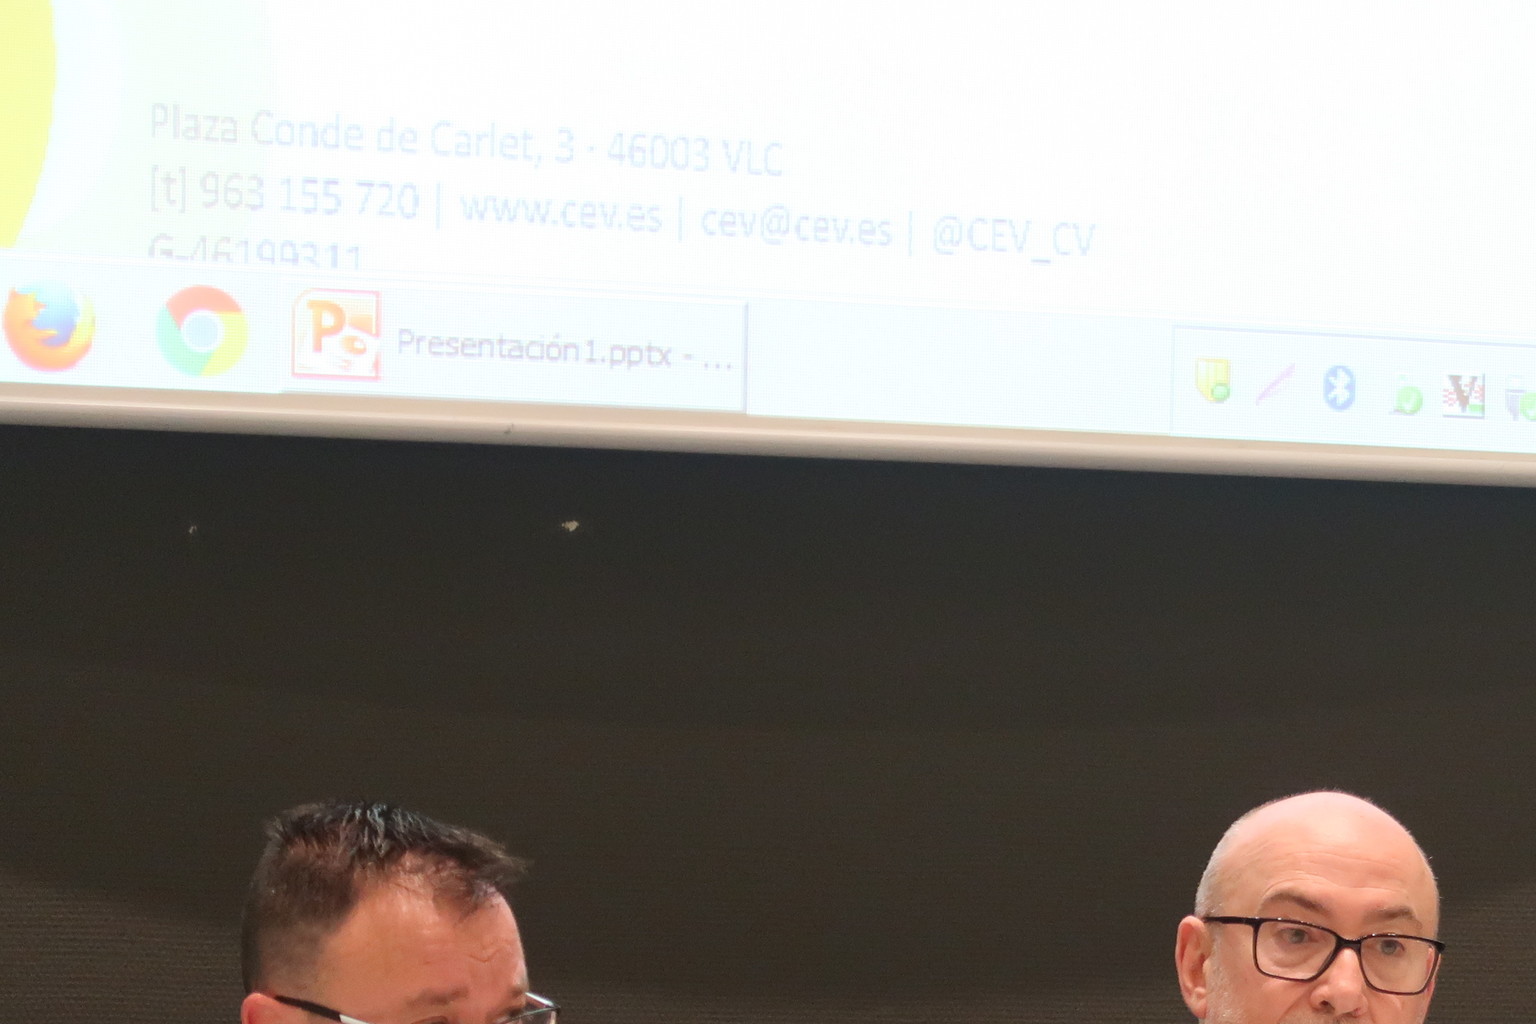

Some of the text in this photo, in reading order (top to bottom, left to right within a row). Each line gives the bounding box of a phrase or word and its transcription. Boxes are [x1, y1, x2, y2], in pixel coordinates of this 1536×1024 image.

[150, 102, 239, 145] Plaza
[251, 109, 364, 152] Conde
[376, 117, 419, 155] de
[430, 121, 542, 168] Carlet,
[554, 127, 576, 164] 3
[607, 130, 710, 172] 46003
[722, 138, 784, 176] VLC
[150, 164, 188, 214] [t]
[200, 170, 266, 211] 963
[279, 175, 344, 216] 155
[356, 179, 420, 220] 720
[460, 191, 664, 234] www.cev.es
[700, 203, 894, 247] cev@cev.es
[932, 213, 1098, 264] @CEV_CV
[398, 327, 673, 371] Presentación1.pptx
